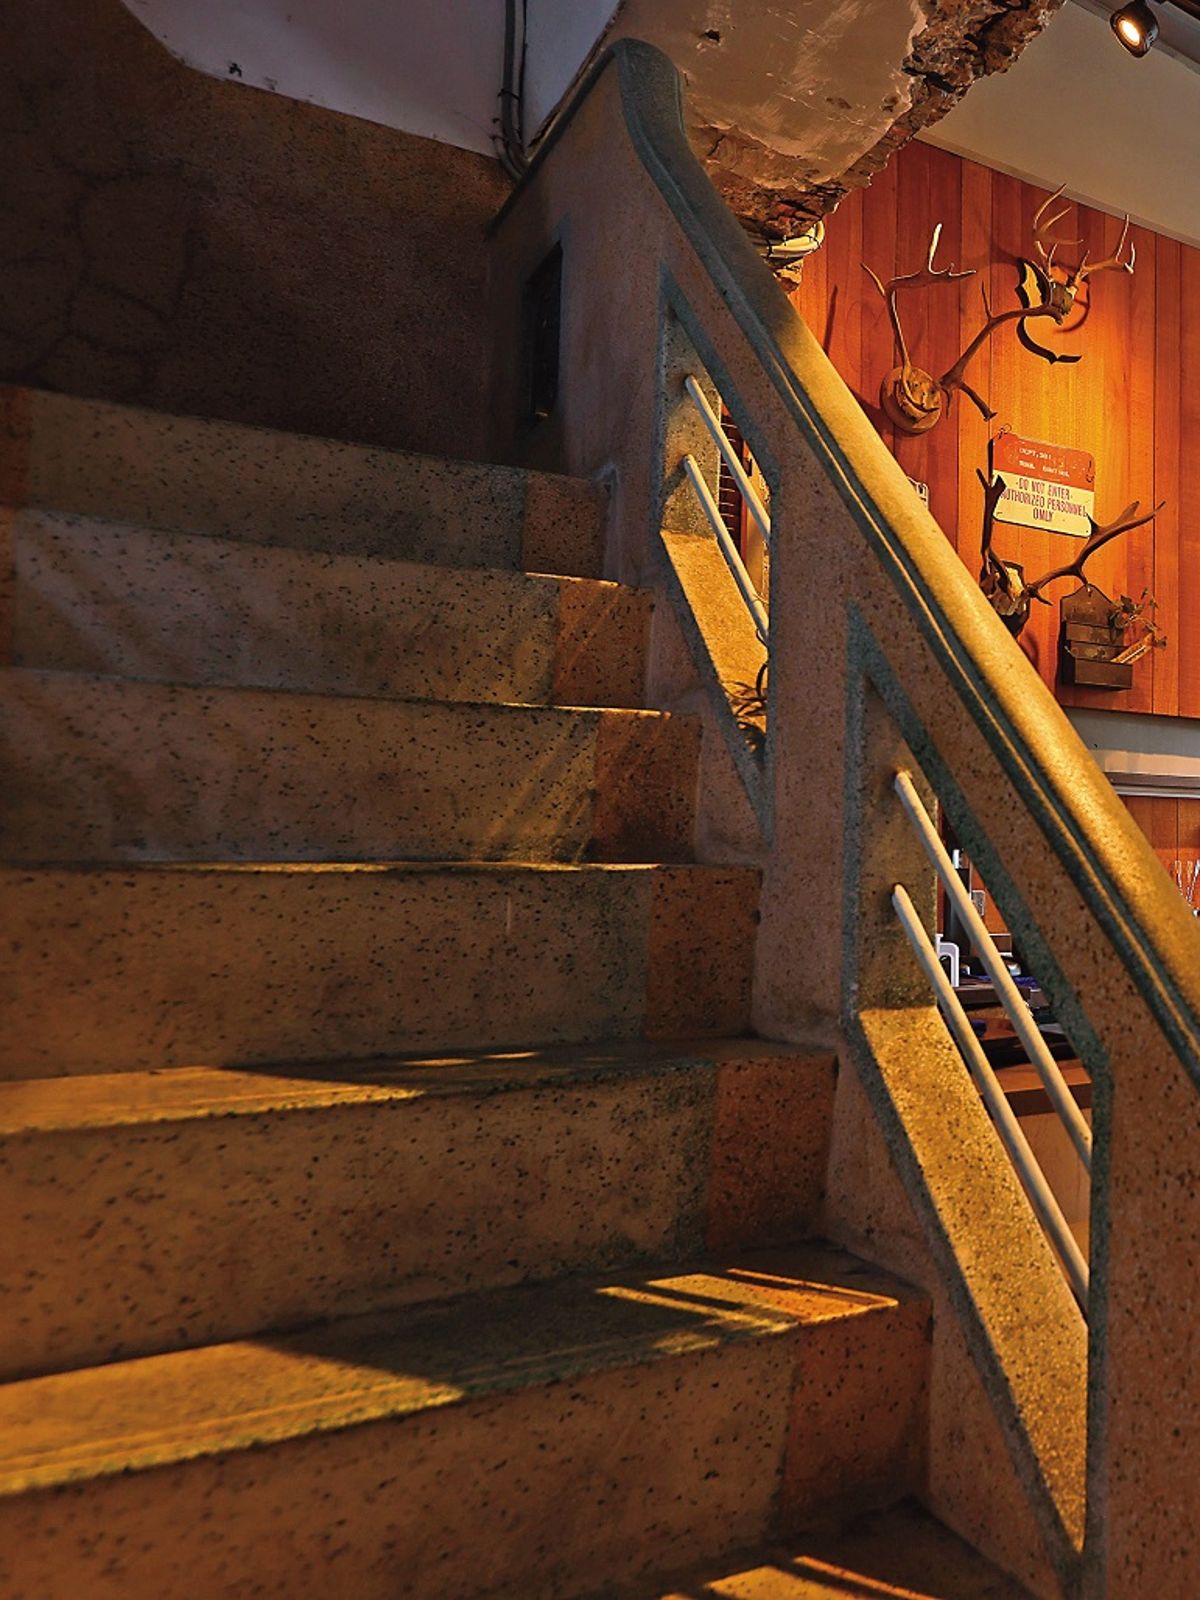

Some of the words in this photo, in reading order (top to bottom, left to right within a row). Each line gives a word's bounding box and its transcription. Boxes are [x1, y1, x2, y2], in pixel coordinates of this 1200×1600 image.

[1018, 478, 1030, 492] DO
[1031, 480, 1046, 495] NOT
[1033, 507, 1054, 523] ONLY
[1047, 497, 1088, 518] PERSONNEL
